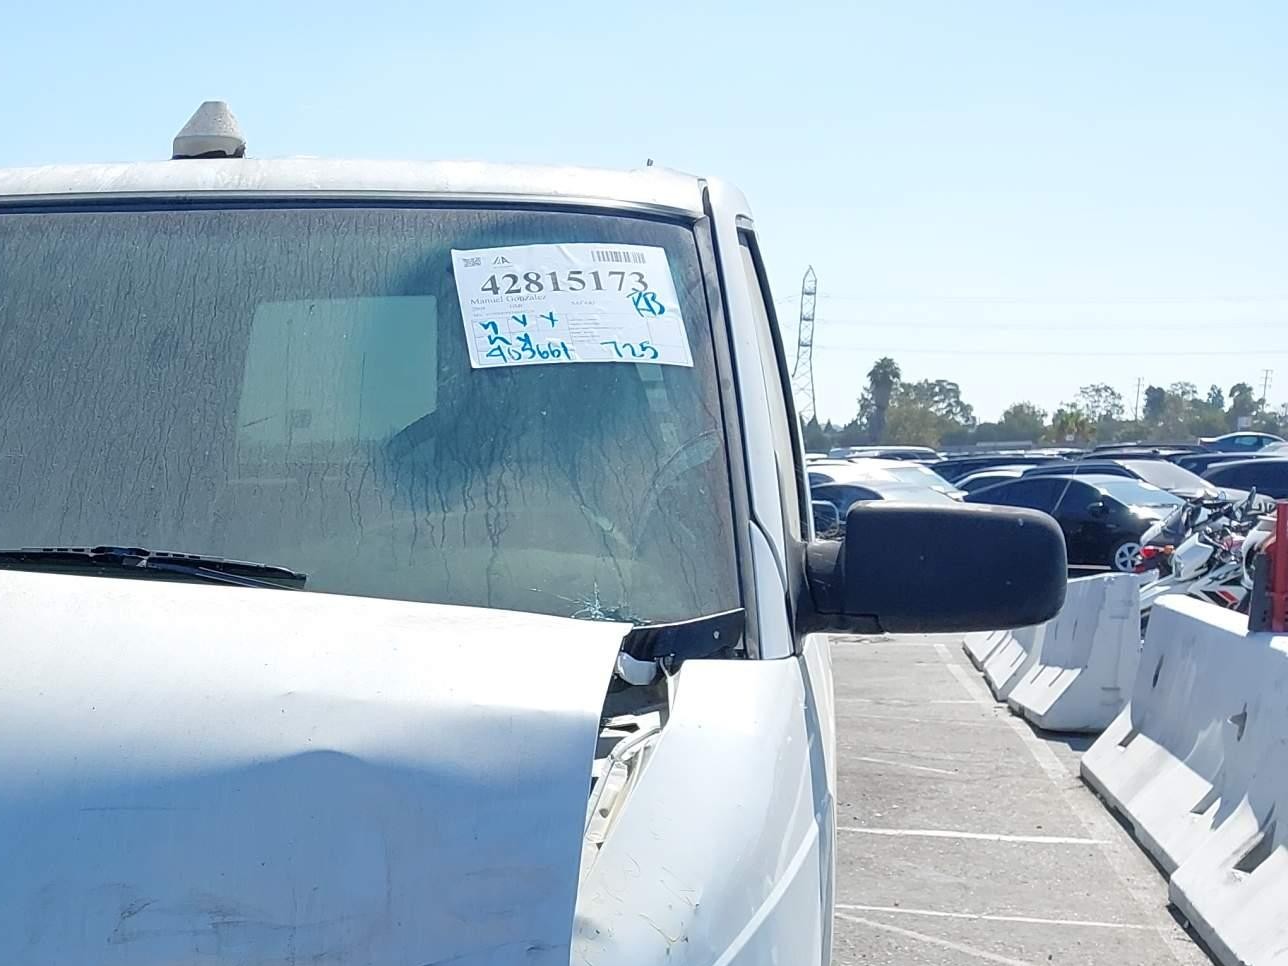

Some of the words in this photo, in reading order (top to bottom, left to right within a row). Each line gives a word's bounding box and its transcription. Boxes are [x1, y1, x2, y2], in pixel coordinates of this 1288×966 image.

[481, 270, 649, 295] 42815173
[470, 296, 504, 305] Manuel
[506, 294, 546, 303] Gonzalez
[599, 340, 659, 360] 725
